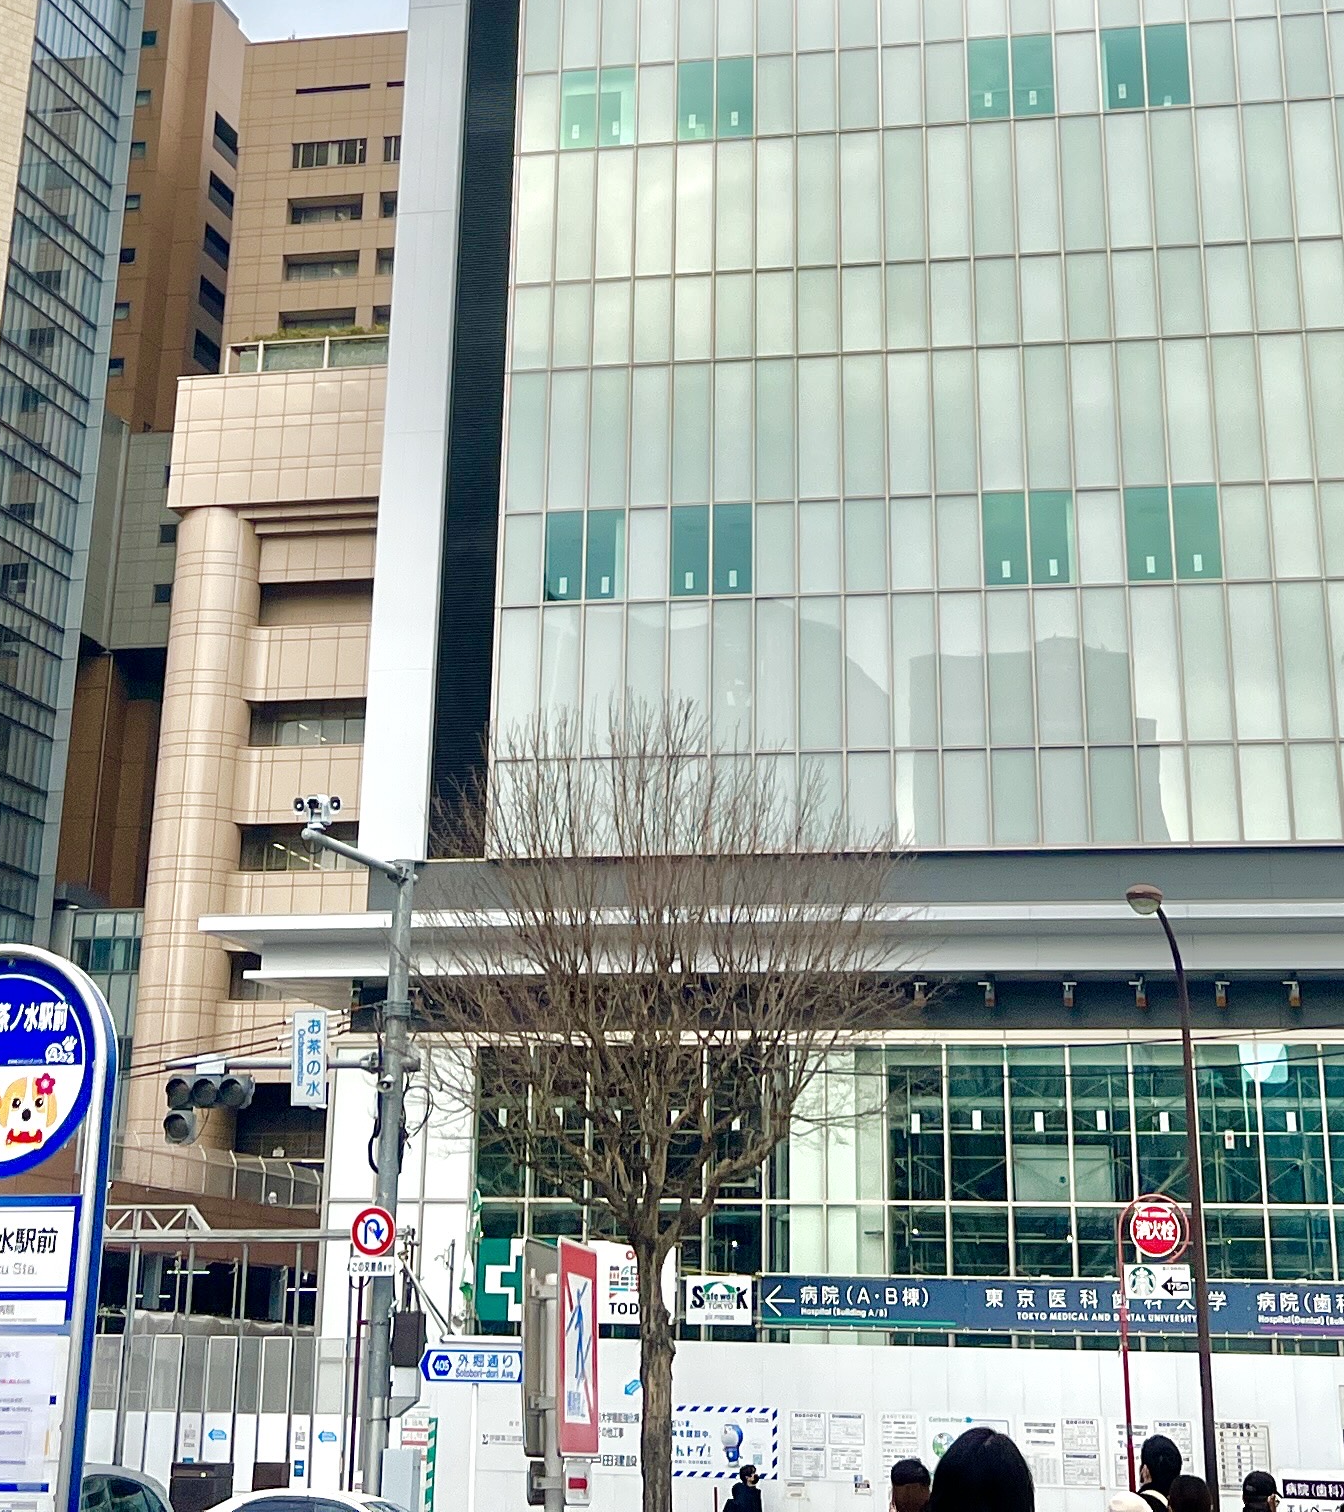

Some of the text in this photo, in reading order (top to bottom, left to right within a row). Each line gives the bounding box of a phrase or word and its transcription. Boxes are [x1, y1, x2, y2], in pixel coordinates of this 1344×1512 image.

[306, 1018, 321, 1096] お茶の水
[1017, 1311, 1047, 1321] TOKYO
[1049, 1311, 1089, 1321] MEDICAL
[1091, 1312, 1111, 1322] AND
[1148, 1313, 1198, 1323] UNIVERSITY
[435, 1360, 450, 1372] 405
